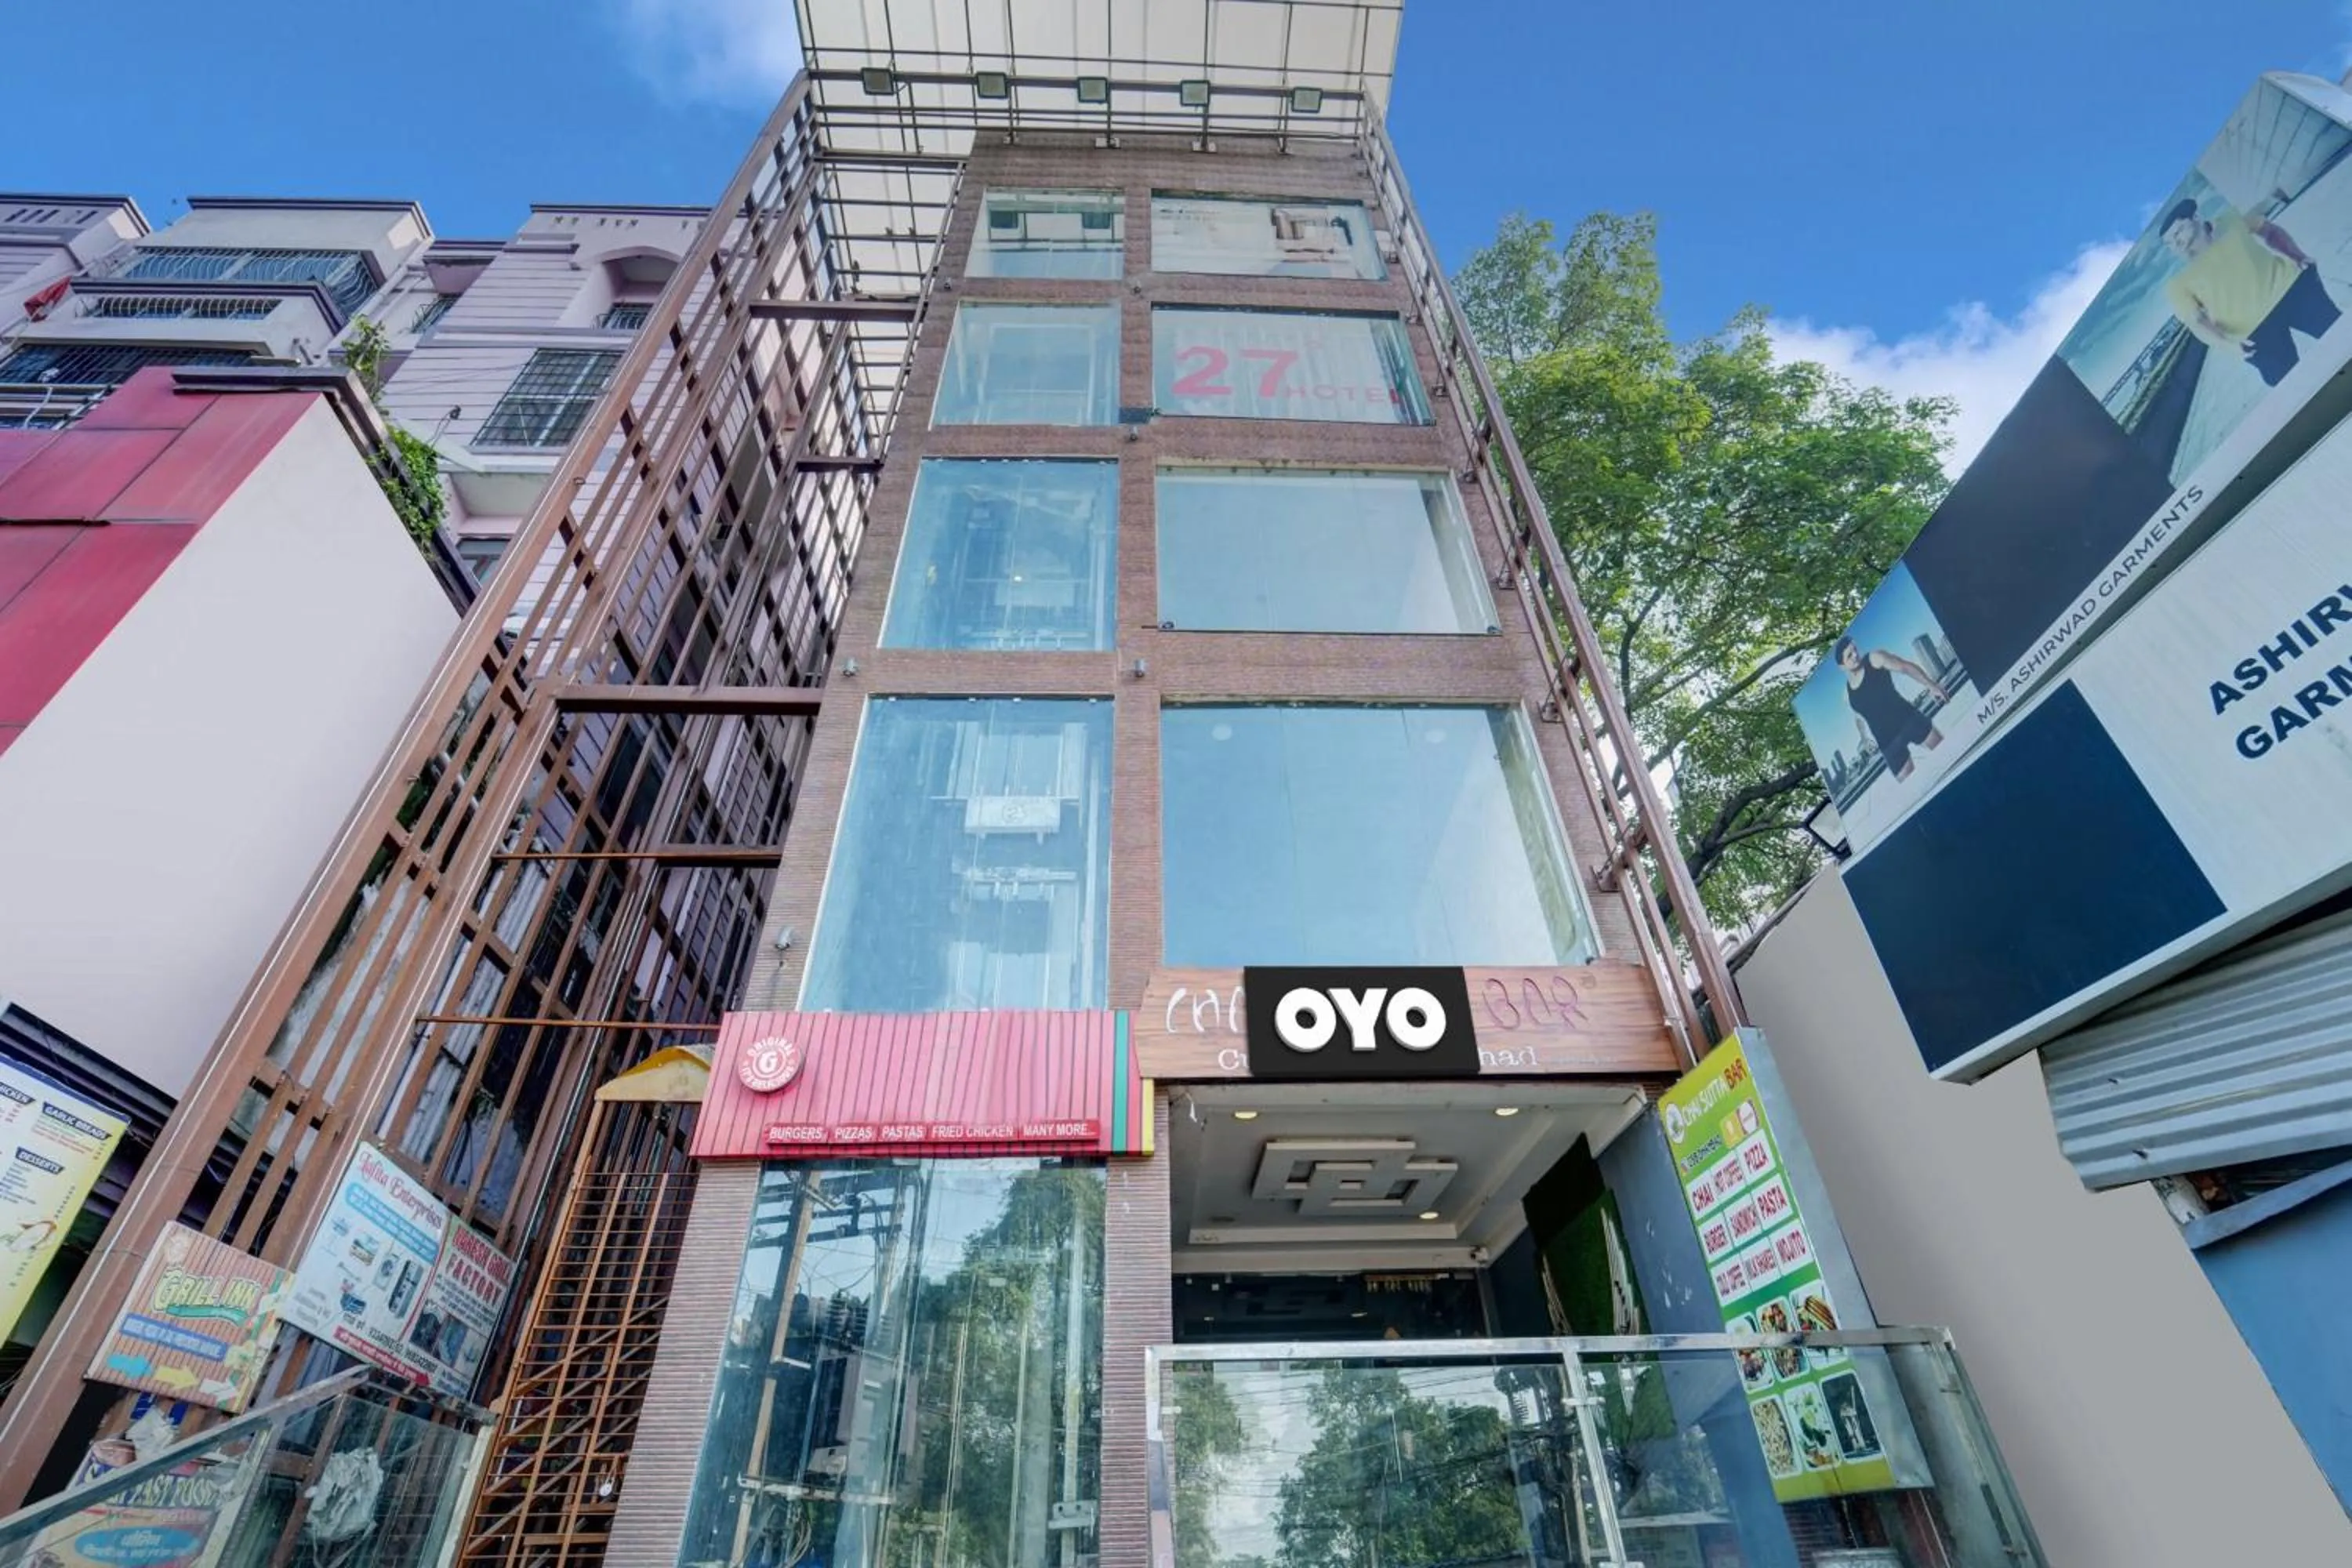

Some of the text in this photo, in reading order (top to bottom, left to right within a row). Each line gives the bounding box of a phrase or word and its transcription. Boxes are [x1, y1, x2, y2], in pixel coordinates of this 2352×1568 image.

[1171, 346, 1298, 398] 27
[1286, 384, 1399, 405] HOTEL
[1976, 485, 2204, 724] M/S. ASHIRWAD GARMENTS
[2209, 584, 2352, 716] ASHIR
[1274, 988, 1446, 1052] OYO
[758, 1051, 778, 1073] G
[1724, 1057, 1747, 1090] BAR
[932, 1125, 963, 1138] FRIED
[966, 1124, 1014, 1138] CHICKEN
[1023, 1124, 1054, 1136] MANY
[1693, 1182, 1715, 1211] CHAI
[1744, 1142, 1769, 1174] PIZZA
[1757, 1185, 1788, 1219] PASTA
[1776, 1229, 1807, 1264] MOJITO
[154, 1268, 223, 1312] GRILL
[223, 1278, 260, 1309] INN
[445, 1252, 503, 1306] FACTORY
